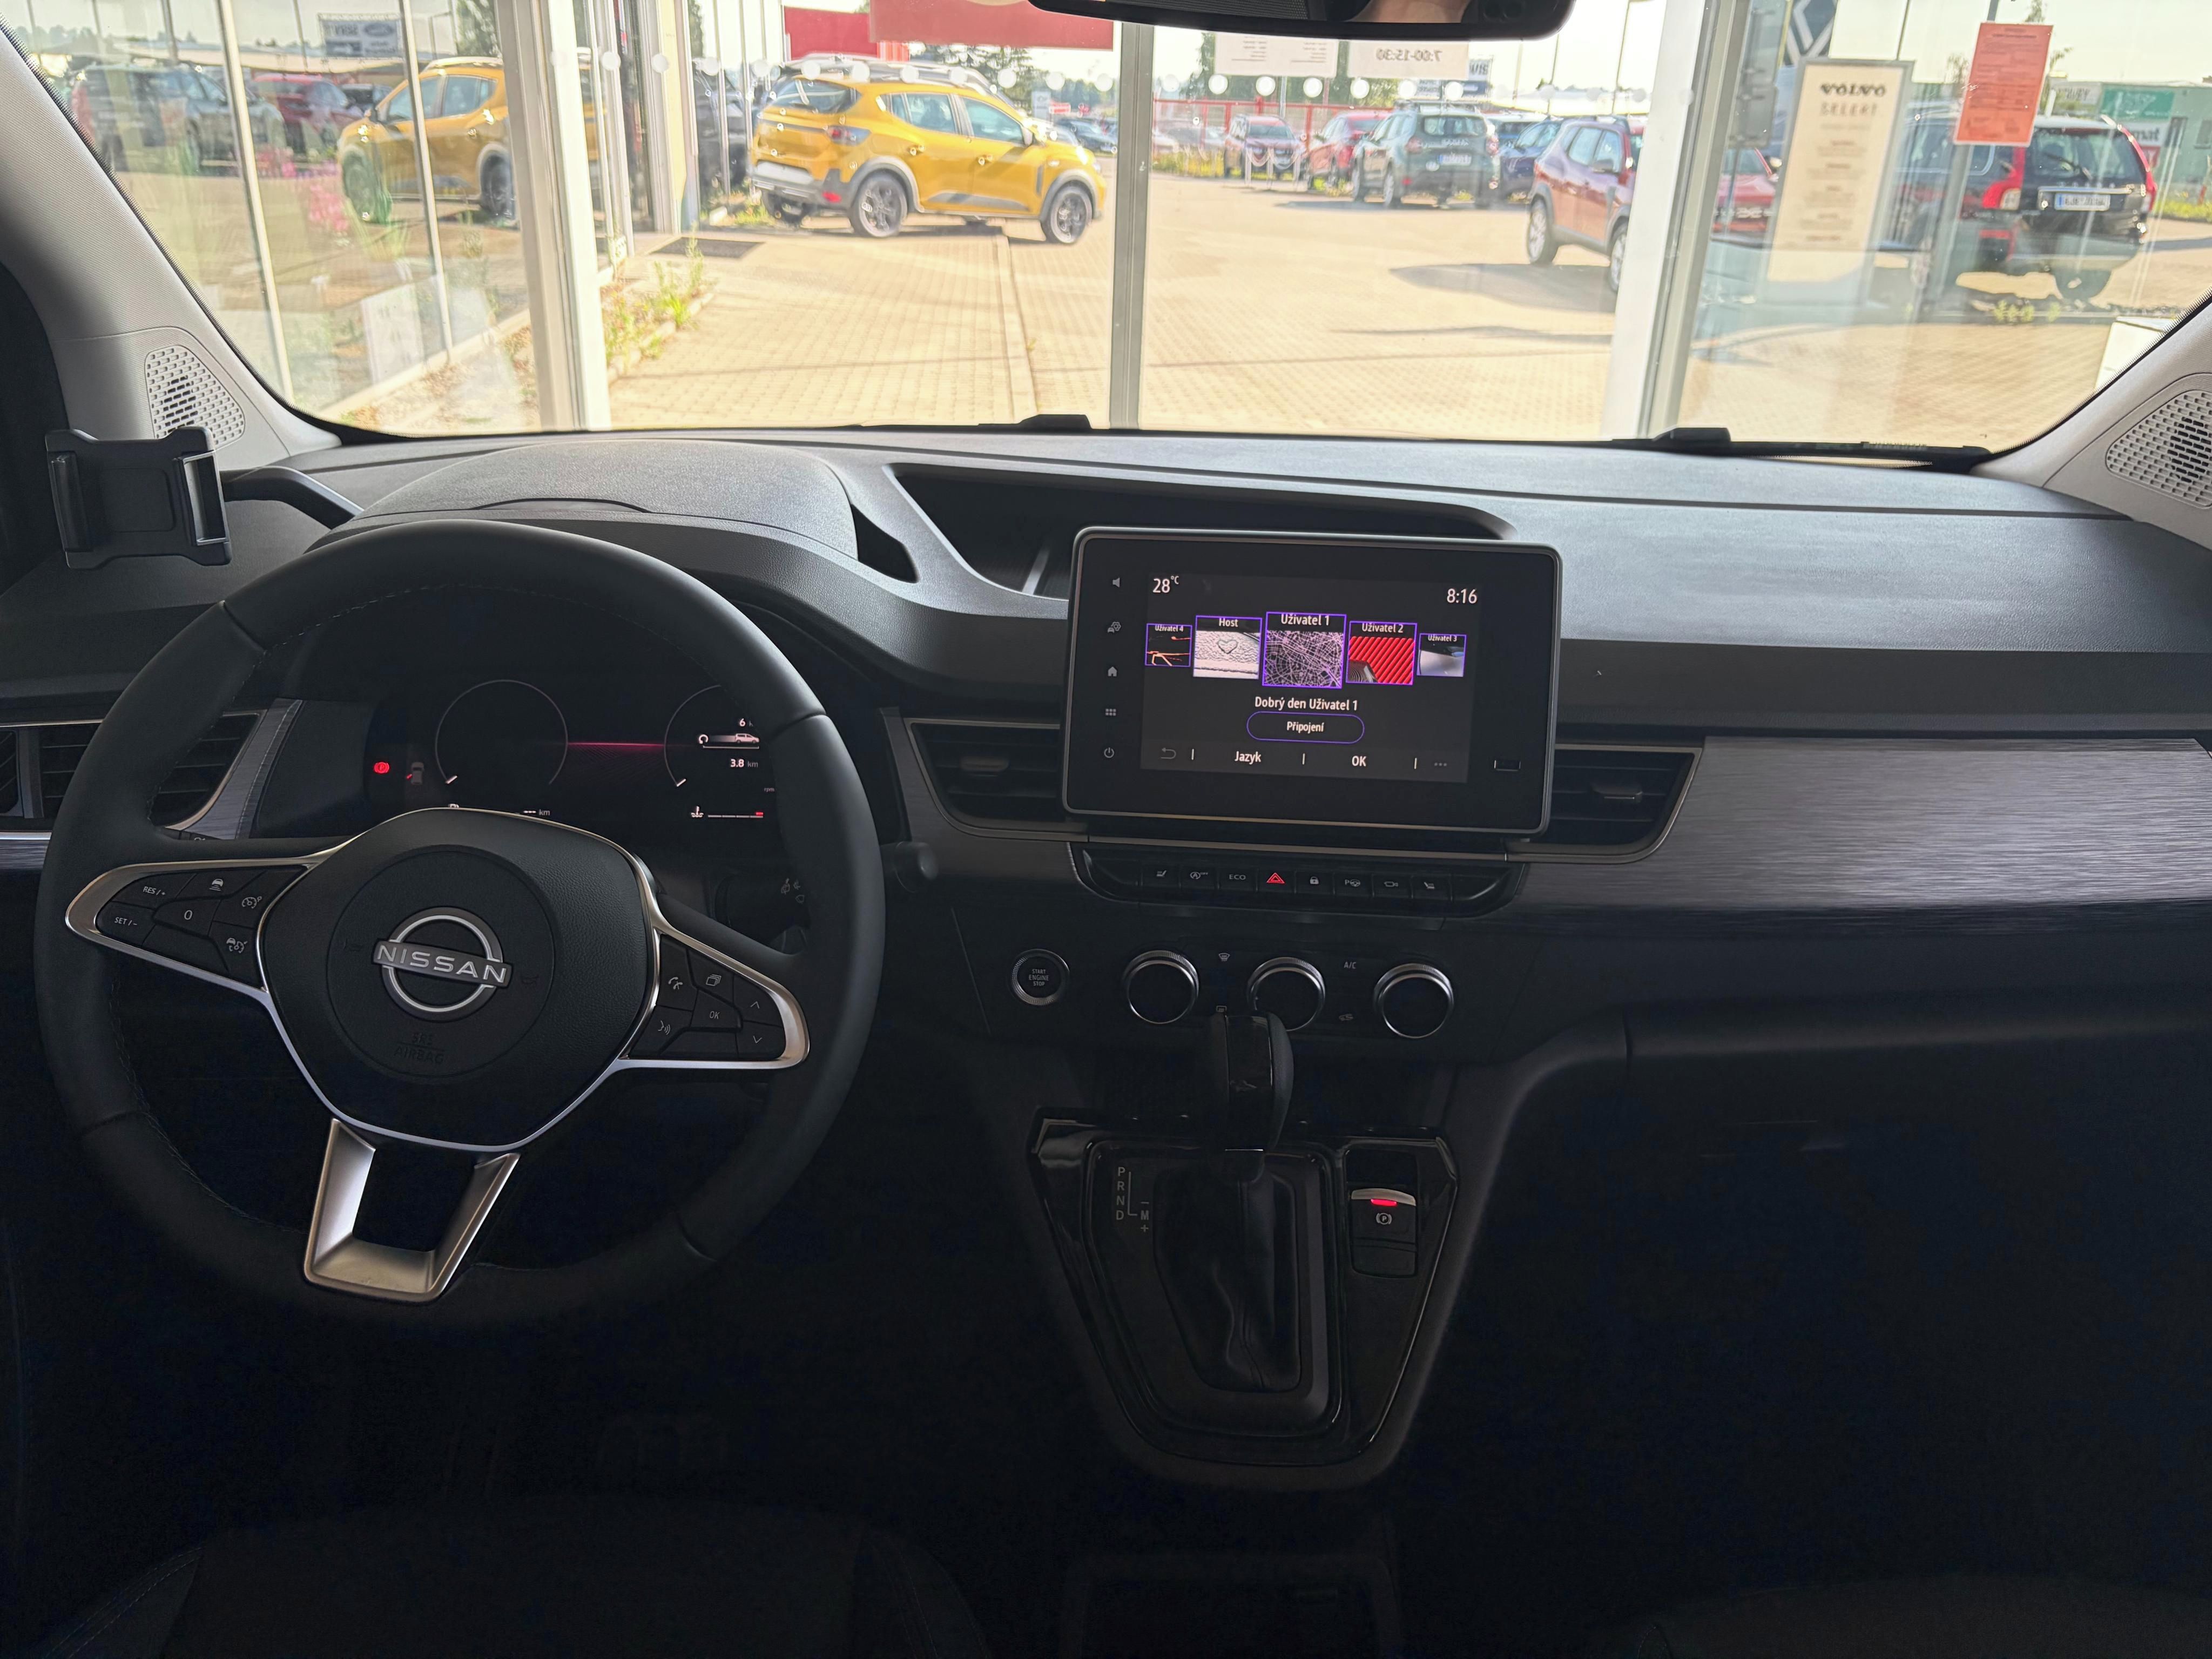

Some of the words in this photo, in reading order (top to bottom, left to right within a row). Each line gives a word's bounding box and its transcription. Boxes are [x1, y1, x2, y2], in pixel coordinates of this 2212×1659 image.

[1820, 83, 1886, 97] VOLVO
[1447, 588, 1477, 604] 8:16
[1219, 617, 1238, 628] Host
[1281, 613, 1321, 626] Uživatel
[1325, 615, 1330, 626] 1
[1362, 623, 1396, 633] Uživatel
[1398, 624, 1404, 633] 2
[1255, 696, 1285, 711] Dobrý
[1287, 697, 1306, 709] den
[1309, 698, 1350, 711] Uživatel
[1352, 700, 1358, 711] 1
[739, 718, 746, 727] 6
[1287, 721, 1325, 734] Připojení
[730, 758, 745, 768] 3.8
[1235, 751, 1262, 765] Jazyk
[1352, 756, 1367, 767] OK
[378, 945, 507, 983] NISSAN
[1344, 961, 1357, 969] A/C
[709, 1010, 720, 1020] OK
[393, 1046, 444, 1064] AIRBAG
[1118, 1166, 1125, 1177] P
[1117, 1181, 1125, 1191] R
[1116, 1195, 1125, 1206] N
[1116, 1210, 1124, 1220] D
[1141, 1210, 1149, 1220] M
